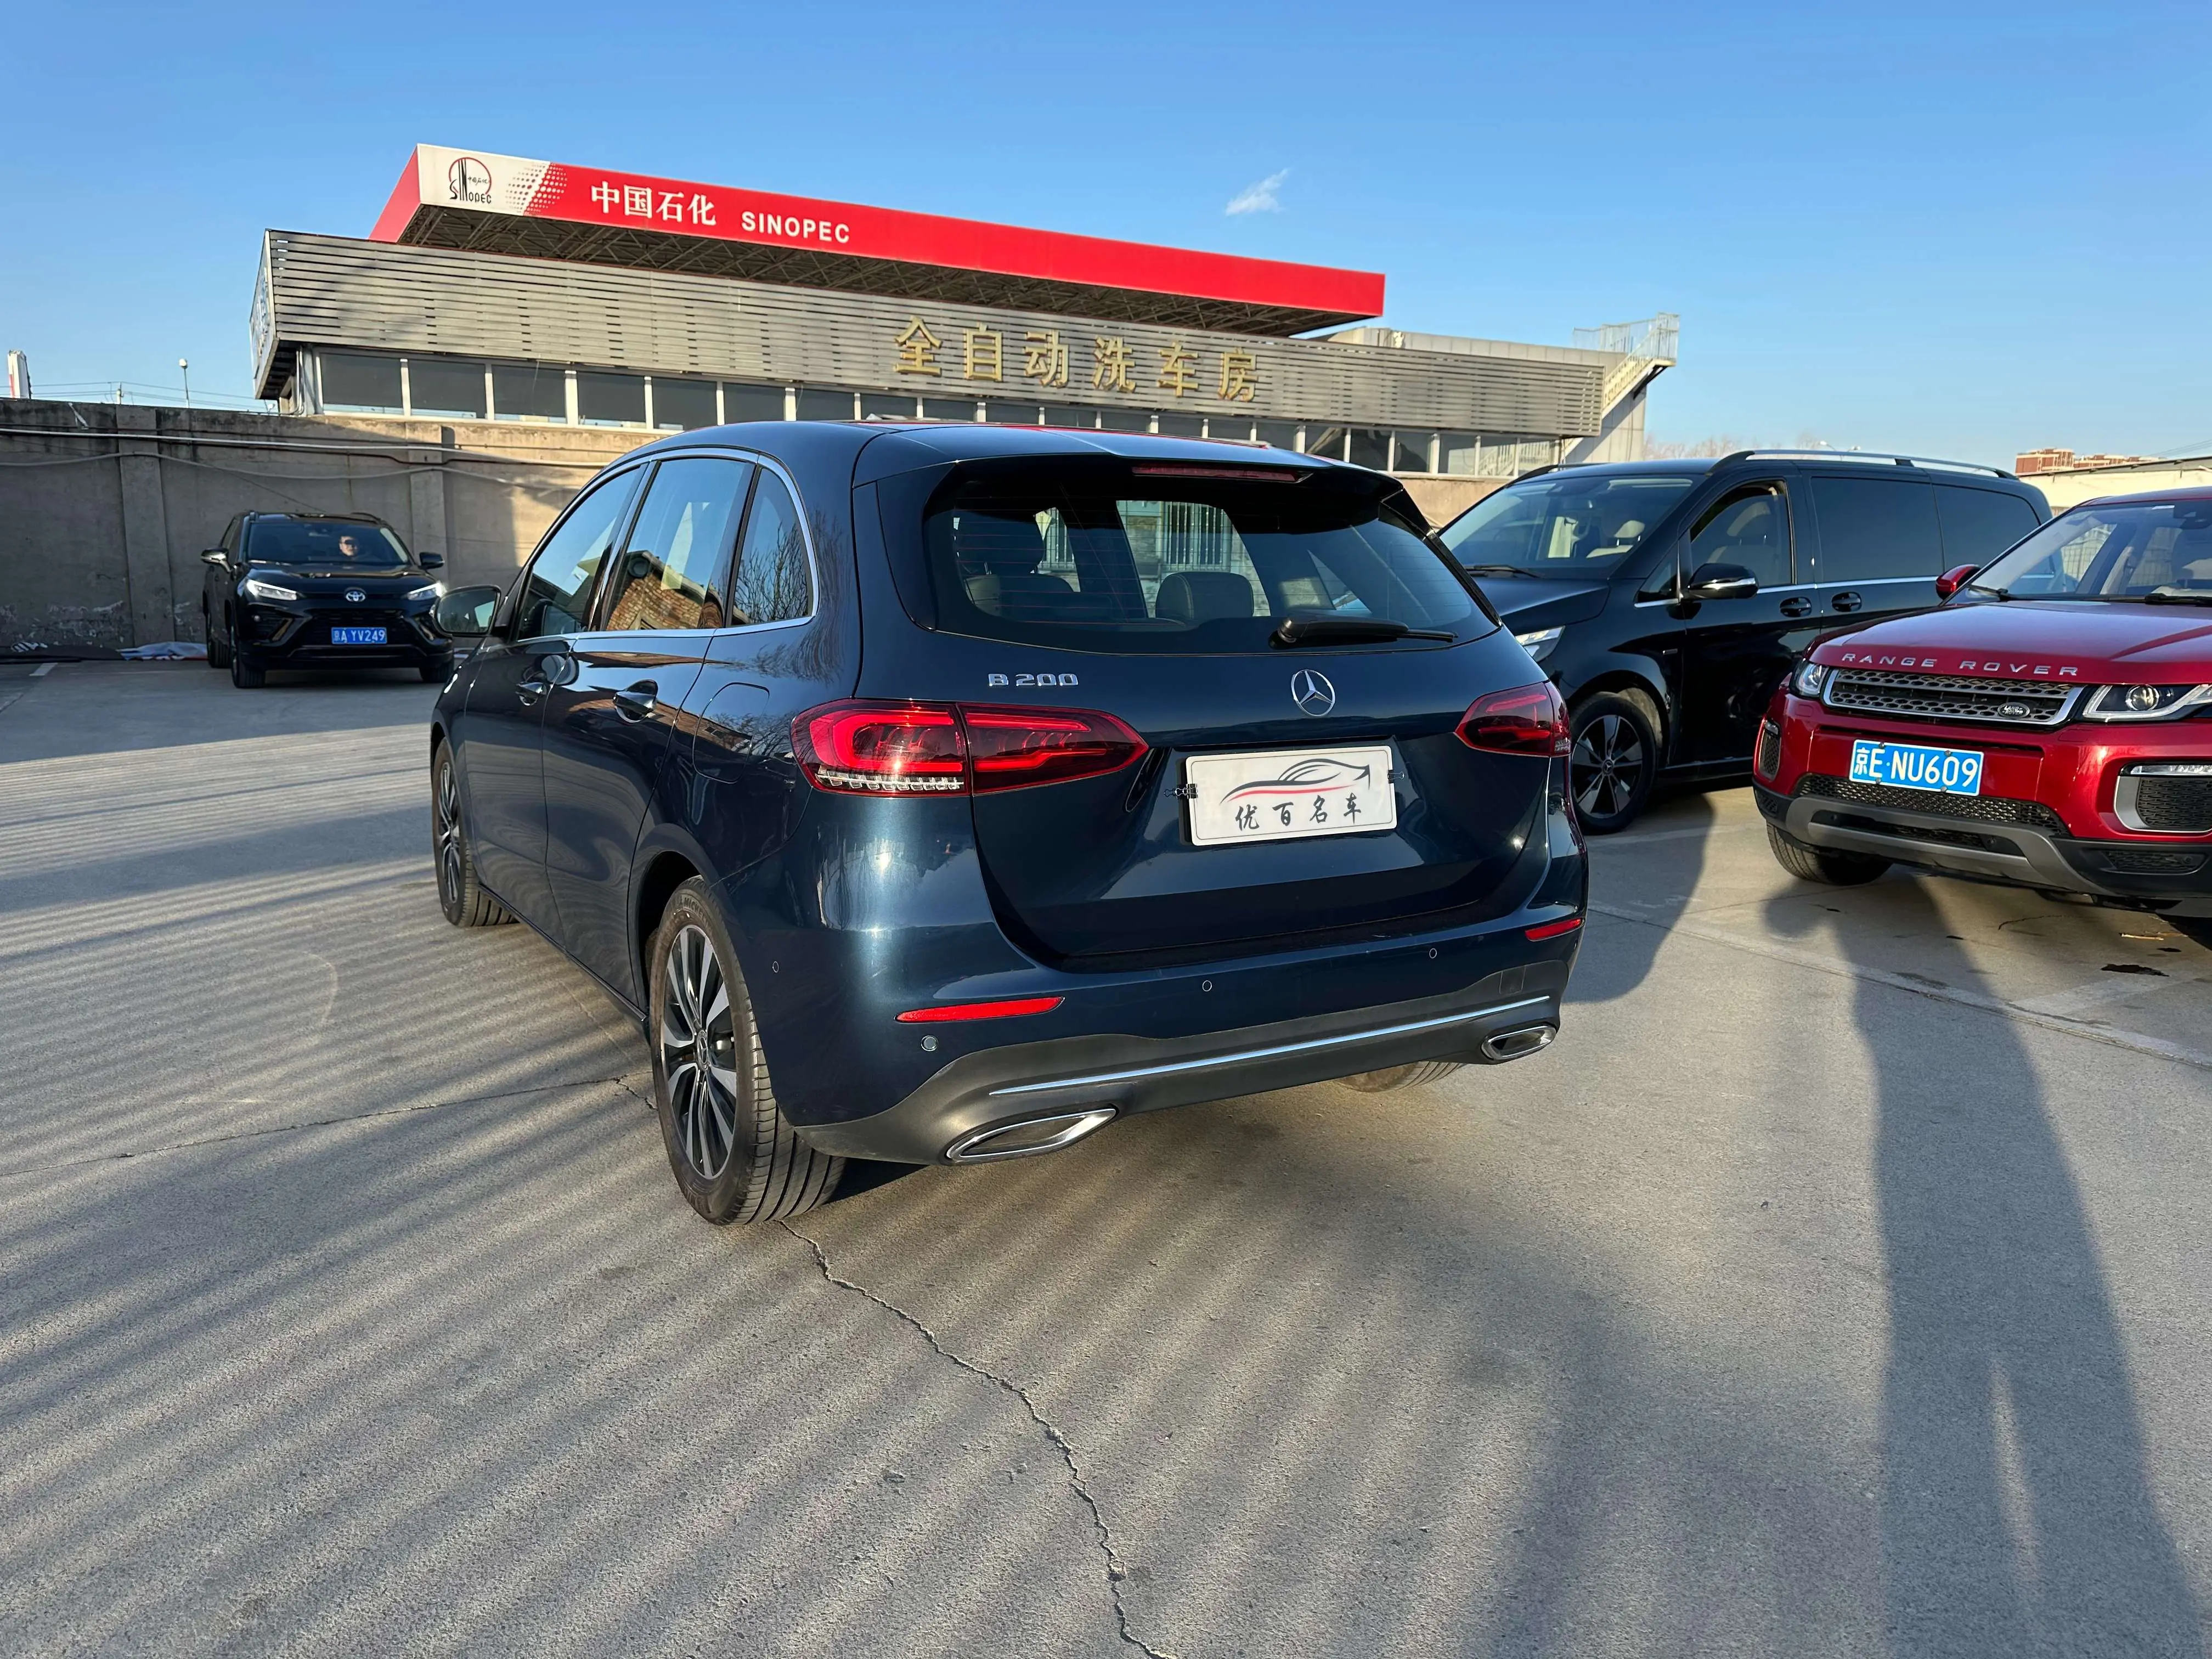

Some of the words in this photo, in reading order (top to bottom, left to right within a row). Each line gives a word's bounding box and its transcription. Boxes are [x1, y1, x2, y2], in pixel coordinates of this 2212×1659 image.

[591, 181, 716, 226] 中国石化
[742, 211, 850, 243] SINOPEC
[894, 315, 1258, 401] 全自动洗车房
[988, 673, 1009, 686] B
[1015, 673, 1079, 686] 200
[1842, 653, 1937, 668] RANGE
[1959, 660, 2080, 676] ROVER
[1235, 792, 1362, 831] 优百名车
